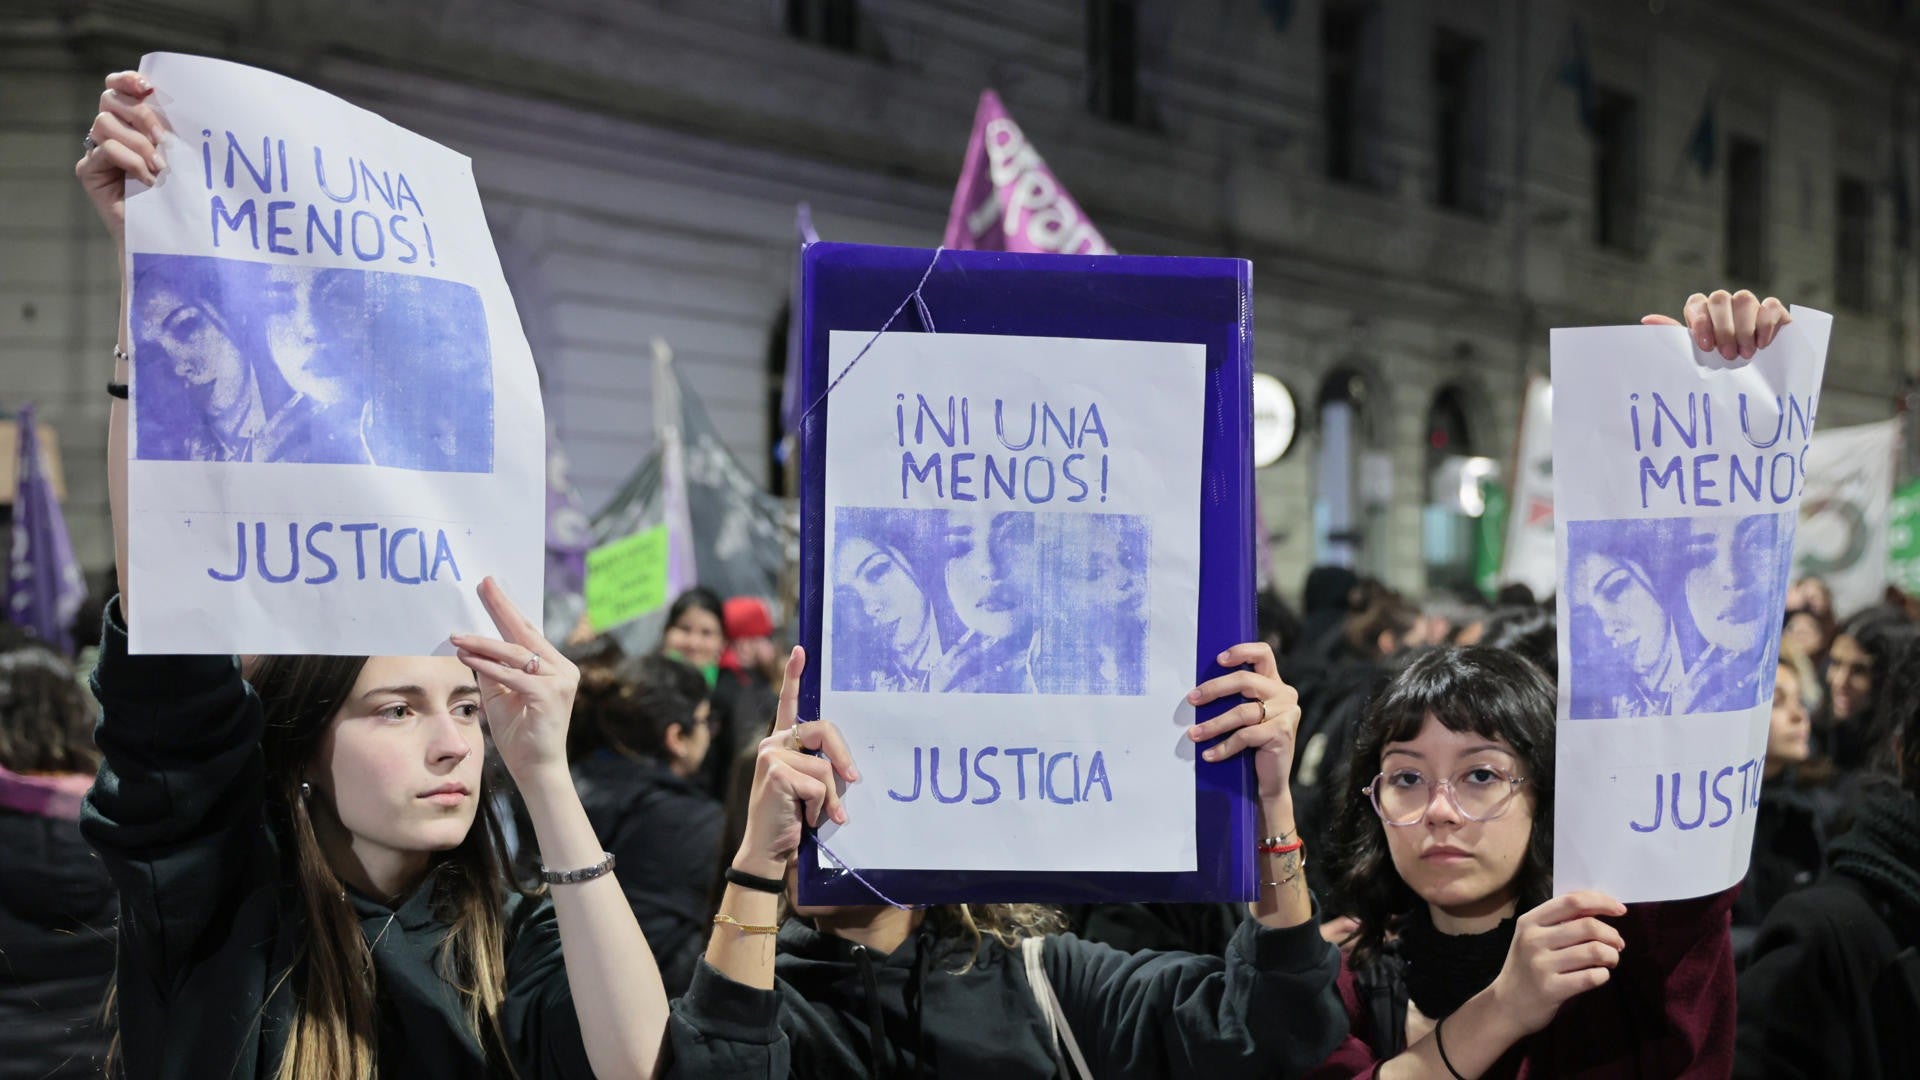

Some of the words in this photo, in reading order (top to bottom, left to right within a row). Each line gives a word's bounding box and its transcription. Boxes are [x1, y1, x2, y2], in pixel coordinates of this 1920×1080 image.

[201, 128, 289, 195] ¡NI
[313, 145, 425, 218] UNA
[209, 194, 437, 269] MENOS!
[896, 391, 971, 449] ¡NI
[994, 396, 1109, 452] UNA
[1629, 390, 1714, 452] ¡NI
[1737, 390, 1817, 449] UN
[901, 449, 1110, 505] MENOS!
[206, 520, 463, 585] JUSTICIA
[886, 745, 1114, 805] JUSTICIA
